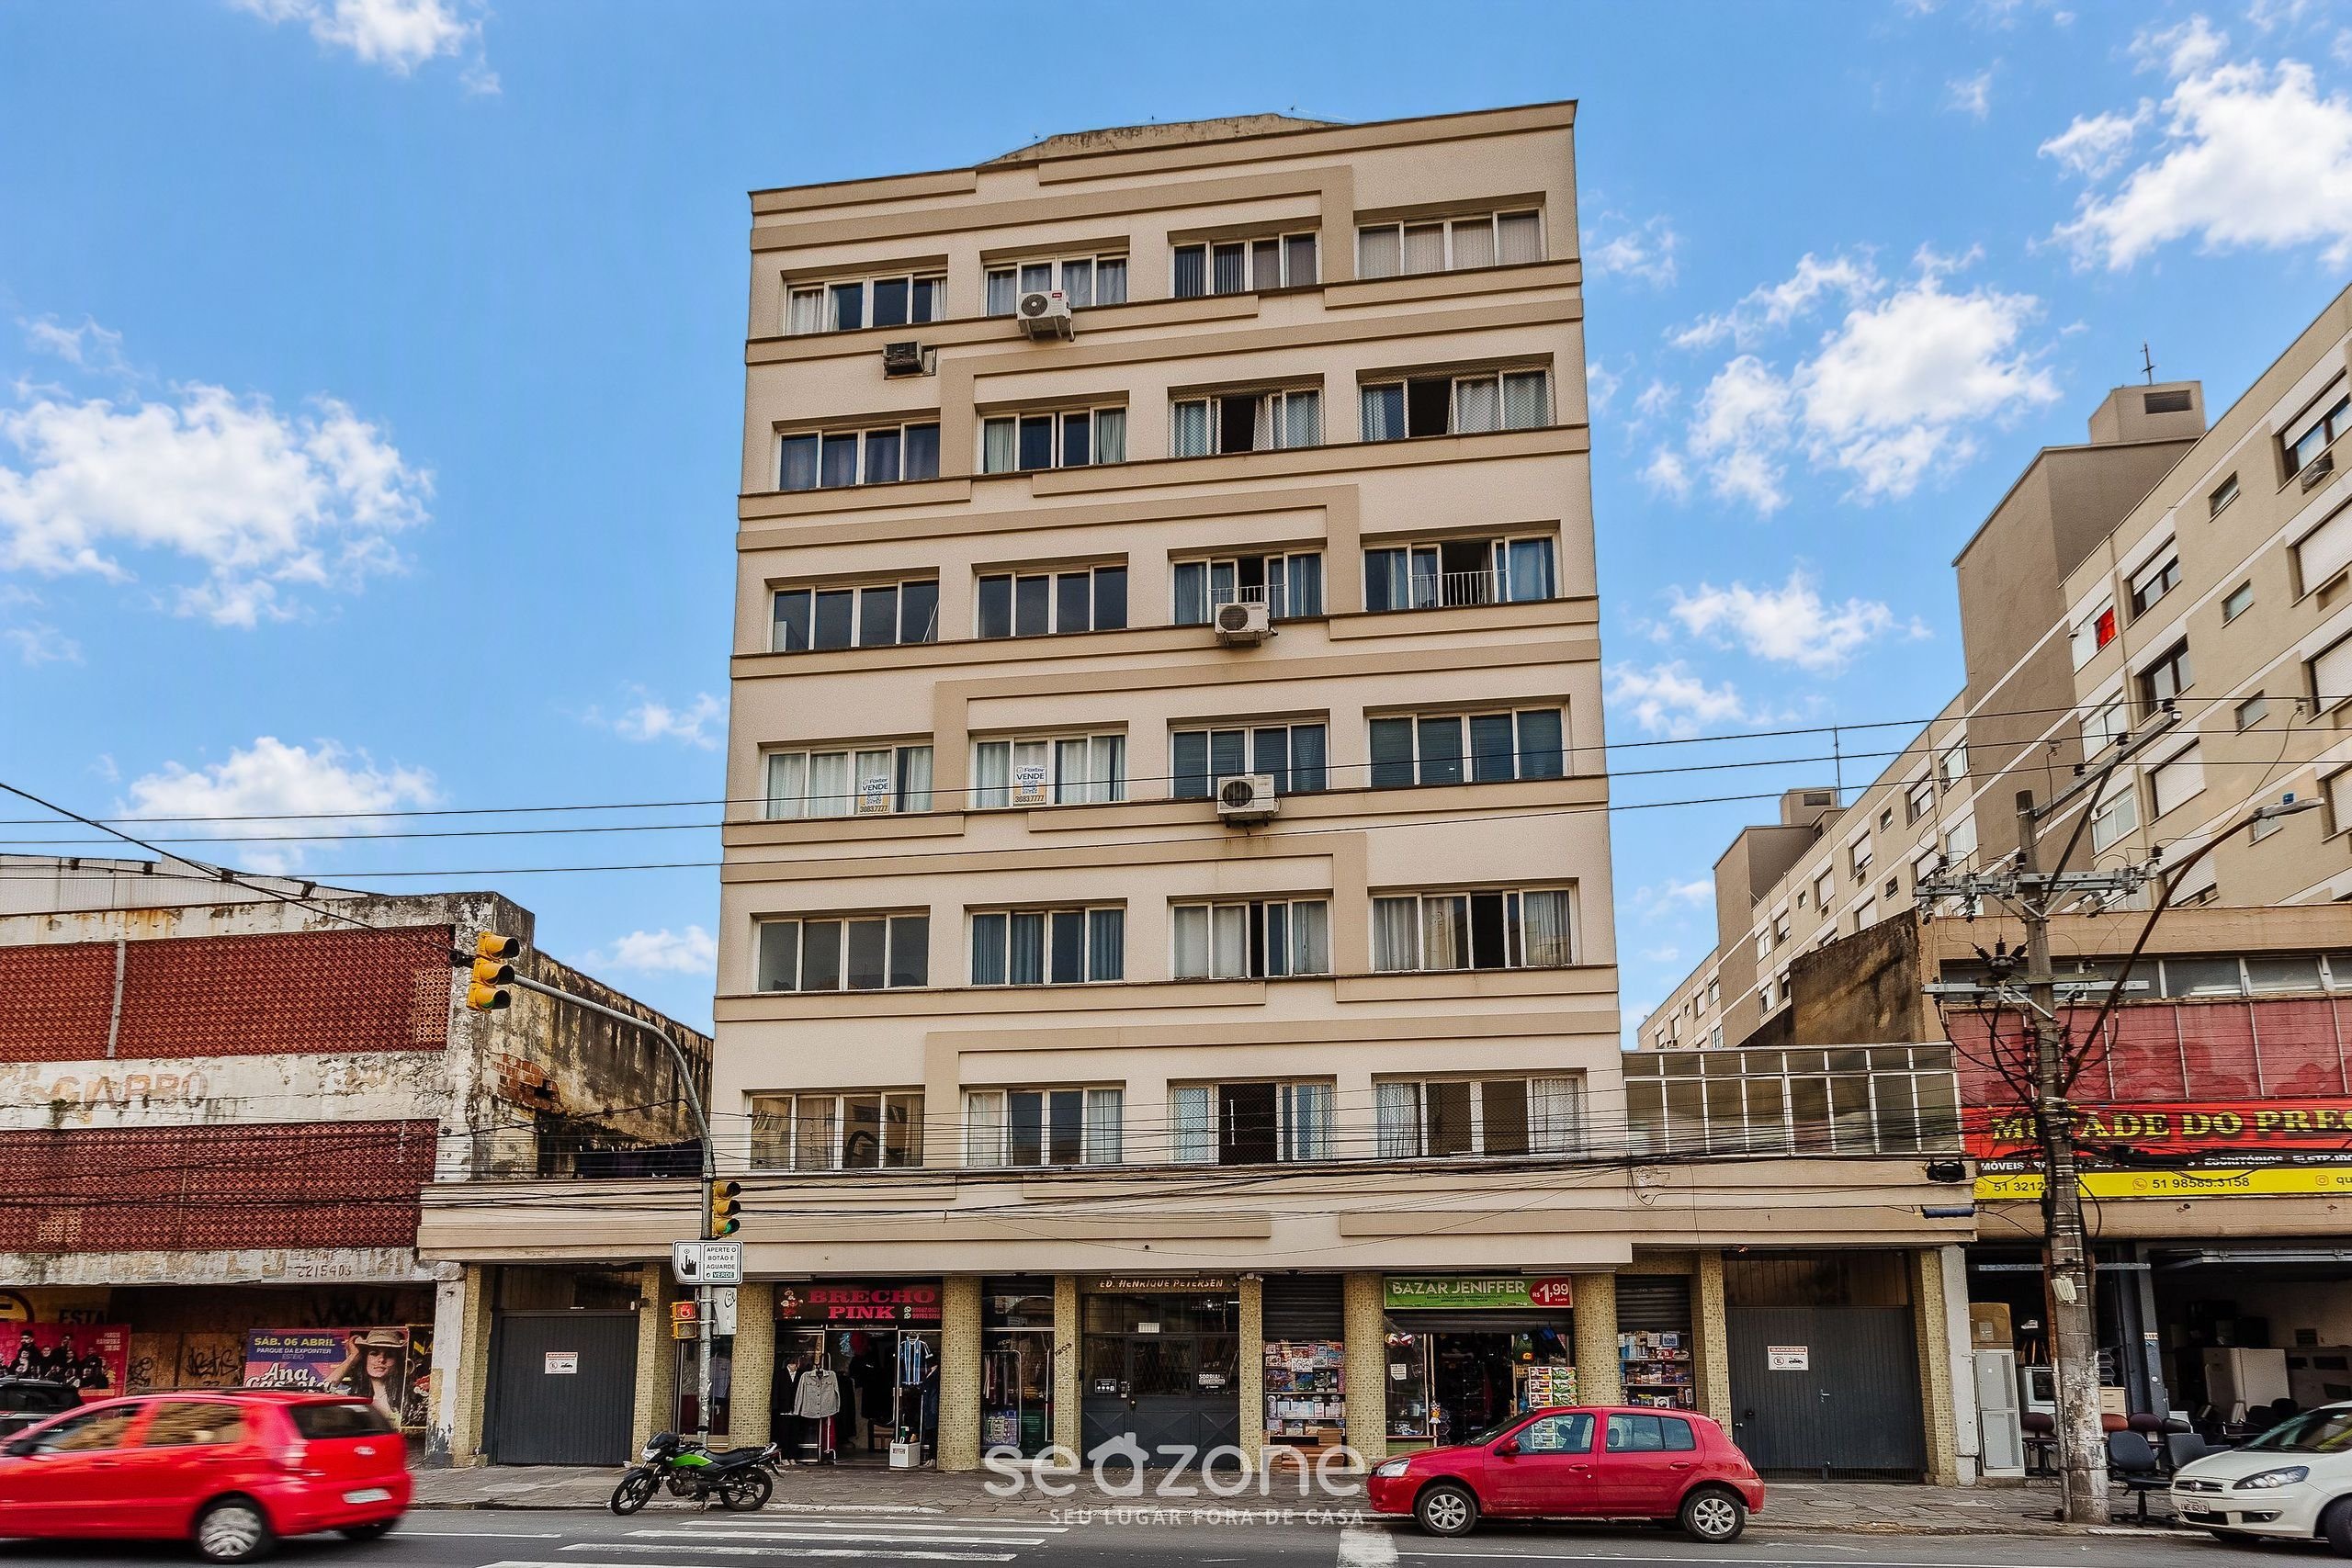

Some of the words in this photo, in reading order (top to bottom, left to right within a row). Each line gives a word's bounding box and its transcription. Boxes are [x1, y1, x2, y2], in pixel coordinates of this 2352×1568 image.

[1991, 1111, 2169, 1139] MADE
[2181, 1111, 2243, 1135] DO
[1981, 1161, 2025, 1171] MÓVEIS
[1994, 1182, 2008, 1191] 51
[2153, 1179, 2167, 1189] 51
[2172, 1177, 2250, 1188] 98585.3158
[1100, 1280, 1115, 1288] ED.
[1118, 1279, 1170, 1288] HENRIQUE
[1173, 1279, 1223, 1288] PETERSEN
[1392, 1282, 1448, 1294] BAZAR
[1452, 1281, 1526, 1294] JENIFFER
[1539, 1283, 1569, 1303] 1,99
[828, 1306, 896, 1319] PINK
[254, 1336, 281, 1346] SÁB.
[284, 1337, 299, 1346] 06
[300, 1337, 335, 1347] ABRIL
[262, 1362, 310, 1383] Ana
